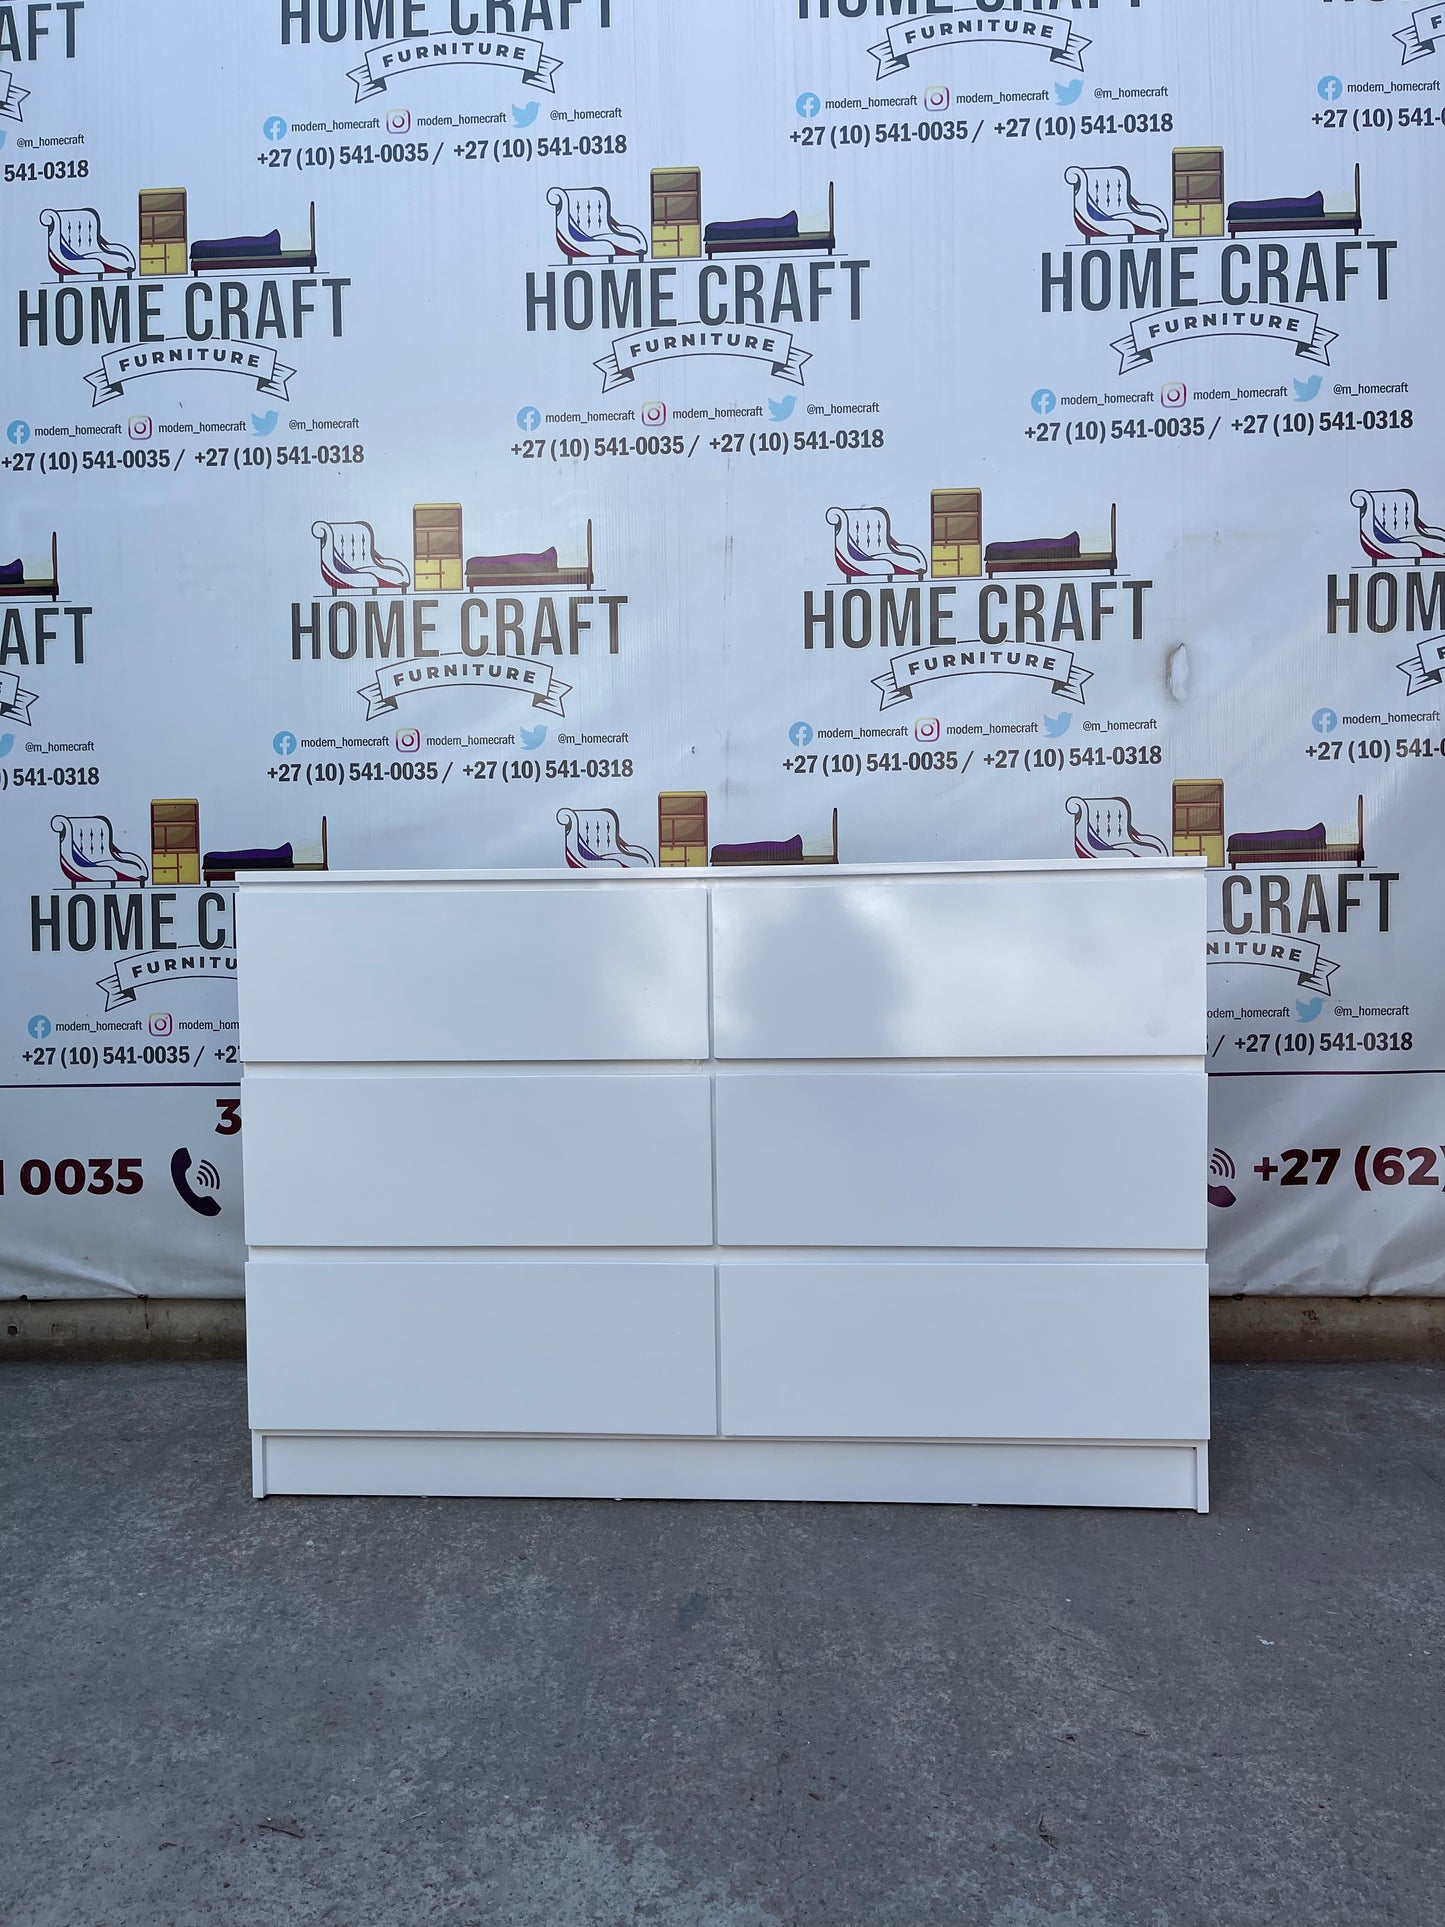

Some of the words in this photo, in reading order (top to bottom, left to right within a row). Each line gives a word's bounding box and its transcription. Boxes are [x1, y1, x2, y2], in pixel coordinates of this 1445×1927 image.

[281, 0, 429, 44] HOME
[905, 19, 1054, 44] FURNITURE
[383, 42, 526, 68] FURNITURE
[1094, 86, 1168, 100] @m_homecraft
[550, 107, 622, 122] @m_homecraft
[1312, 109, 1347, 128] +27
[1353, 108, 1393, 131] (10)
[17, 134, 84, 149] @m_homecraft
[790, 126, 825, 146] +27
[831, 125, 870, 149] (10)
[875, 121, 968, 143] 541-0035
[971, 120, 984, 143] /
[994, 118, 1030, 137] +27
[1036, 116, 1075, 140] (10)
[1081, 113, 1173, 134] 541-0318
[257, 149, 291, 167] +27
[297, 147, 334, 170] (10)
[340, 143, 428, 164] 541-0035
[432, 142, 444, 165] /
[454, 140, 488, 159] +27
[494, 139, 532, 162] (10)
[537, 135, 627, 156] 541-0318
[4, 160, 88, 182] 541-0318
[1042, 247, 1198, 313] HOME
[1221, 241, 1397, 306] CRAFT
[526, 267, 677, 331] HOME
[699, 260, 870, 326] CRAFT
[19, 284, 164, 347] HOME
[185, 278, 351, 341] CRAFT
[1148, 312, 1300, 338] FURNITURE
[630, 332, 775, 358] FURNITURE
[119, 348, 260, 372] FURNITURE
[1333, 382, 1408, 396] @m_homecraft
[807, 402, 879, 416] @m_homecraft
[289, 418, 359, 431] @m_homecraft
[1025, 423, 1060, 441] +27
[1066, 421, 1106, 445] (10)
[1111, 417, 1204, 439] 541-0035
[1208, 416, 1221, 440] /
[1231, 415, 1268, 434] +27
[1274, 413, 1314, 437] (10)
[1319, 409, 1413, 431] 541-0318
[511, 440, 545, 458] +27
[551, 439, 589, 462] (10)
[594, 436, 684, 456] 541-0035
[688, 435, 700, 458] /
[710, 434, 744, 452] +27
[750, 432, 788, 456] (10)
[794, 429, 884, 450] 541-0318
[2, 453, 35, 471] +27
[40, 452, 77, 474] (10)
[82, 449, 170, 469] 541-0035
[174, 449, 185, 471] /
[195, 448, 228, 466] +27
[234, 447, 272, 470] (10)
[277, 445, 364, 465] 541-0318
[804, 586, 957, 649] HOME
[979, 580, 1153, 645] CRAFT
[291, 599, 439, 660] HOME
[461, 596, 628, 657] CRAFT
[393, 663, 536, 687] FURNITURE
[908, 651, 1056, 676] FURNITURE
[1083, 719, 1157, 732] @m_homecraft
[25, 741, 94, 754] @m_homecraft
[558, 733, 629, 745] @m_homecraft
[1306, 741, 1342, 760] +27
[1349, 740, 1390, 763] (10)
[267, 764, 301, 781] +27
[307, 763, 344, 785] (10)
[349, 762, 438, 781] 541-0035
[442, 762, 453, 784] /
[463, 761, 497, 779] +27
[503, 760, 540, 783] (10)
[545, 759, 633, 778] 541-0318
[783, 755, 817, 773] +27
[823, 754, 861, 777] (10)
[867, 751, 958, 771] 541-0035
[961, 751, 974, 773] /
[984, 750, 1019, 768] +27
[1024, 749, 1064, 772] (10)
[1069, 745, 1162, 766] 541-0318
[13, 767, 99, 786] 541-0318
[1222, 873, 1399, 935] CRAFT
[31, 893, 177, 952] HOME
[1334, 1005, 1409, 1018] @m_homecraft
[22, 1048, 56, 1065] +27
[61, 1047, 98, 1069] (10)
[103, 1046, 190, 1064] 541-0035
[193, 1046, 205, 1067] /
[215, 1045, 241, 1064] +2
[1212, 1035, 1225, 1057] /
[1235, 1034, 1270, 1052] +27
[1275, 1033, 1314, 1056] (10)
[1320, 1032, 1412, 1051] 541-0318
[20, 1158, 143, 1195] 0035
[1254, 1148, 1341, 1186] +27
